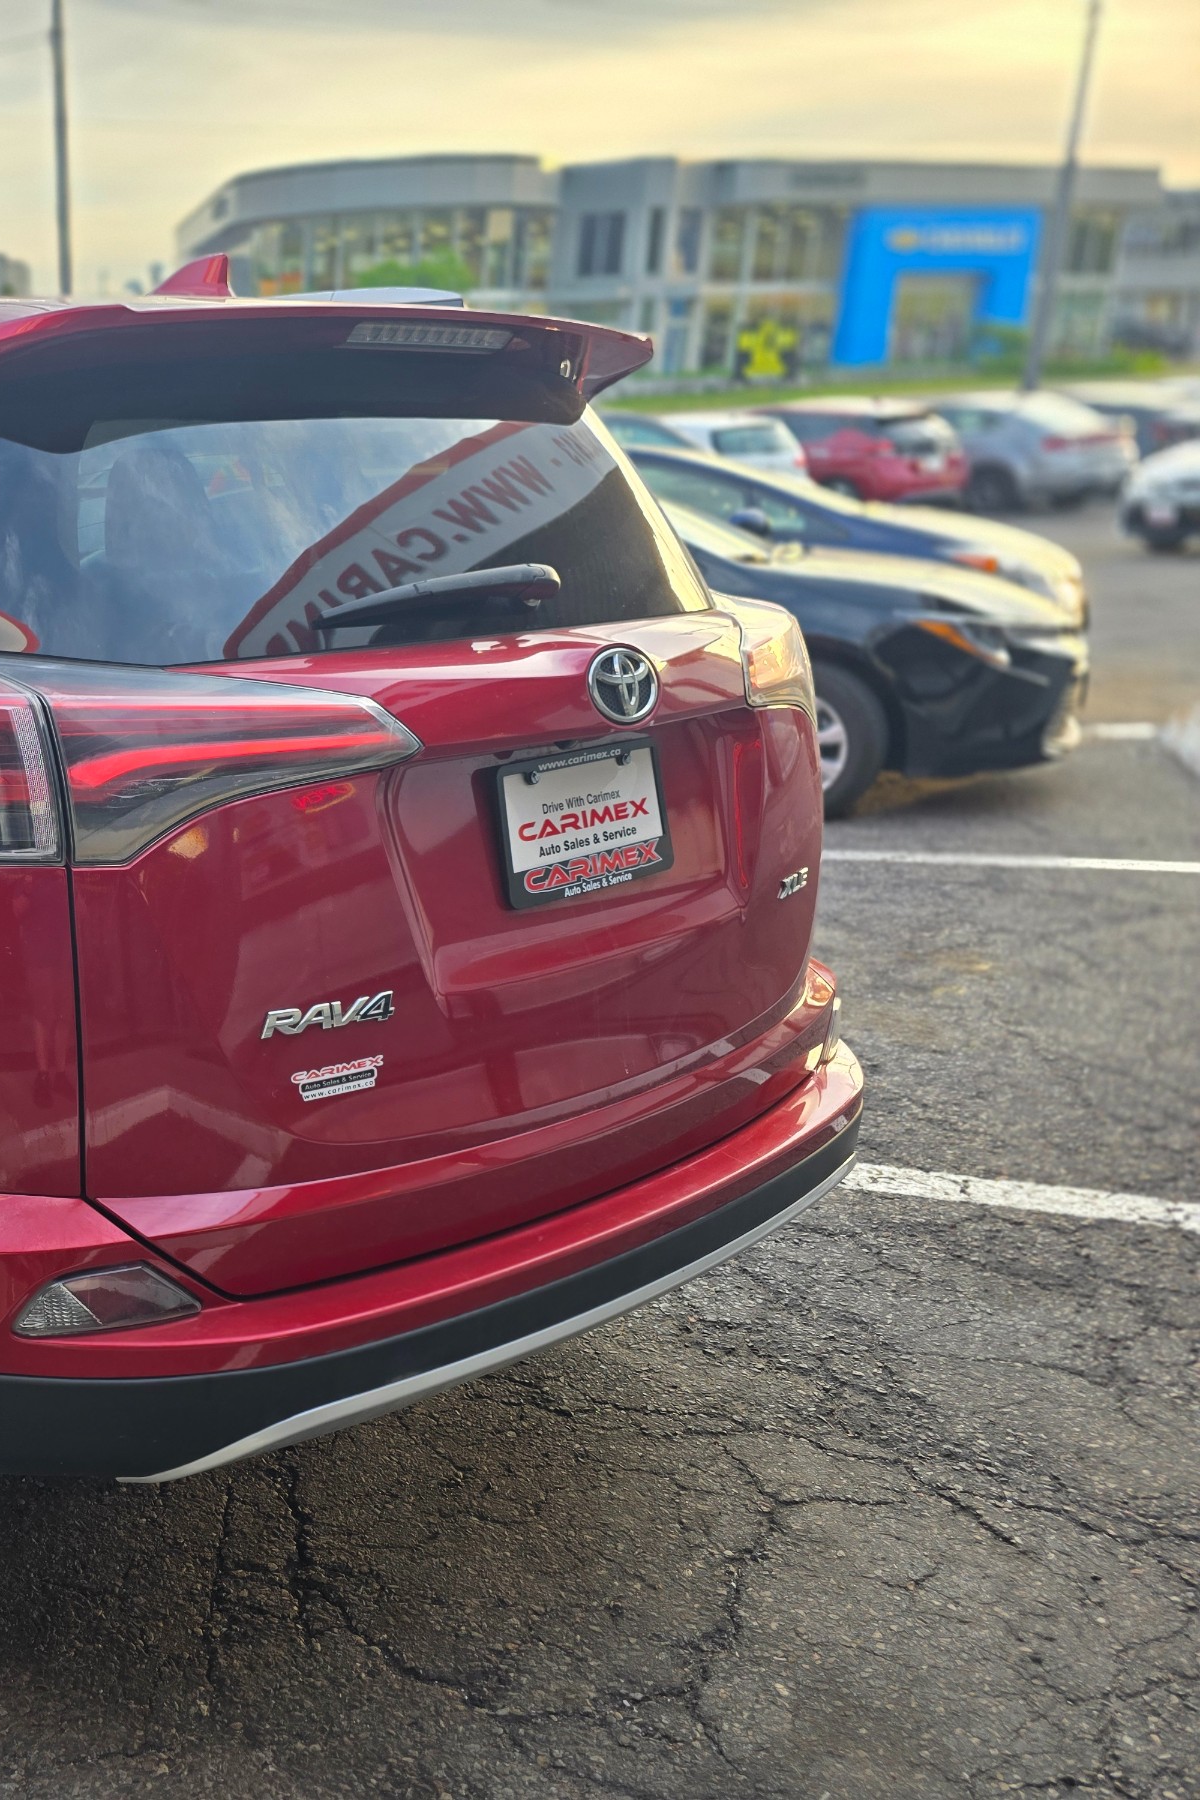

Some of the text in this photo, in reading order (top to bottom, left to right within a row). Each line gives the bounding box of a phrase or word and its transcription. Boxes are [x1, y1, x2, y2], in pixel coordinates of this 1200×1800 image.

[538, 749, 621, 771] www.carimex.ca
[542, 789, 621, 815] Drive With Carimex
[518, 797, 649, 842] CARIMEX
[539, 825, 637, 857] Auto Sales & Service
[524, 840, 662, 892] CARIMEX
[564, 872, 633, 898] Auto Sales & Service
[777, 867, 808, 899] XLE
[261, 990, 395, 1039] RAV4
[292, 1056, 383, 1082] CARIMEX
[304, 1082, 321, 1091] Auto
[322, 1078, 340, 1087] Sales
[348, 1071, 372, 1081] Service
